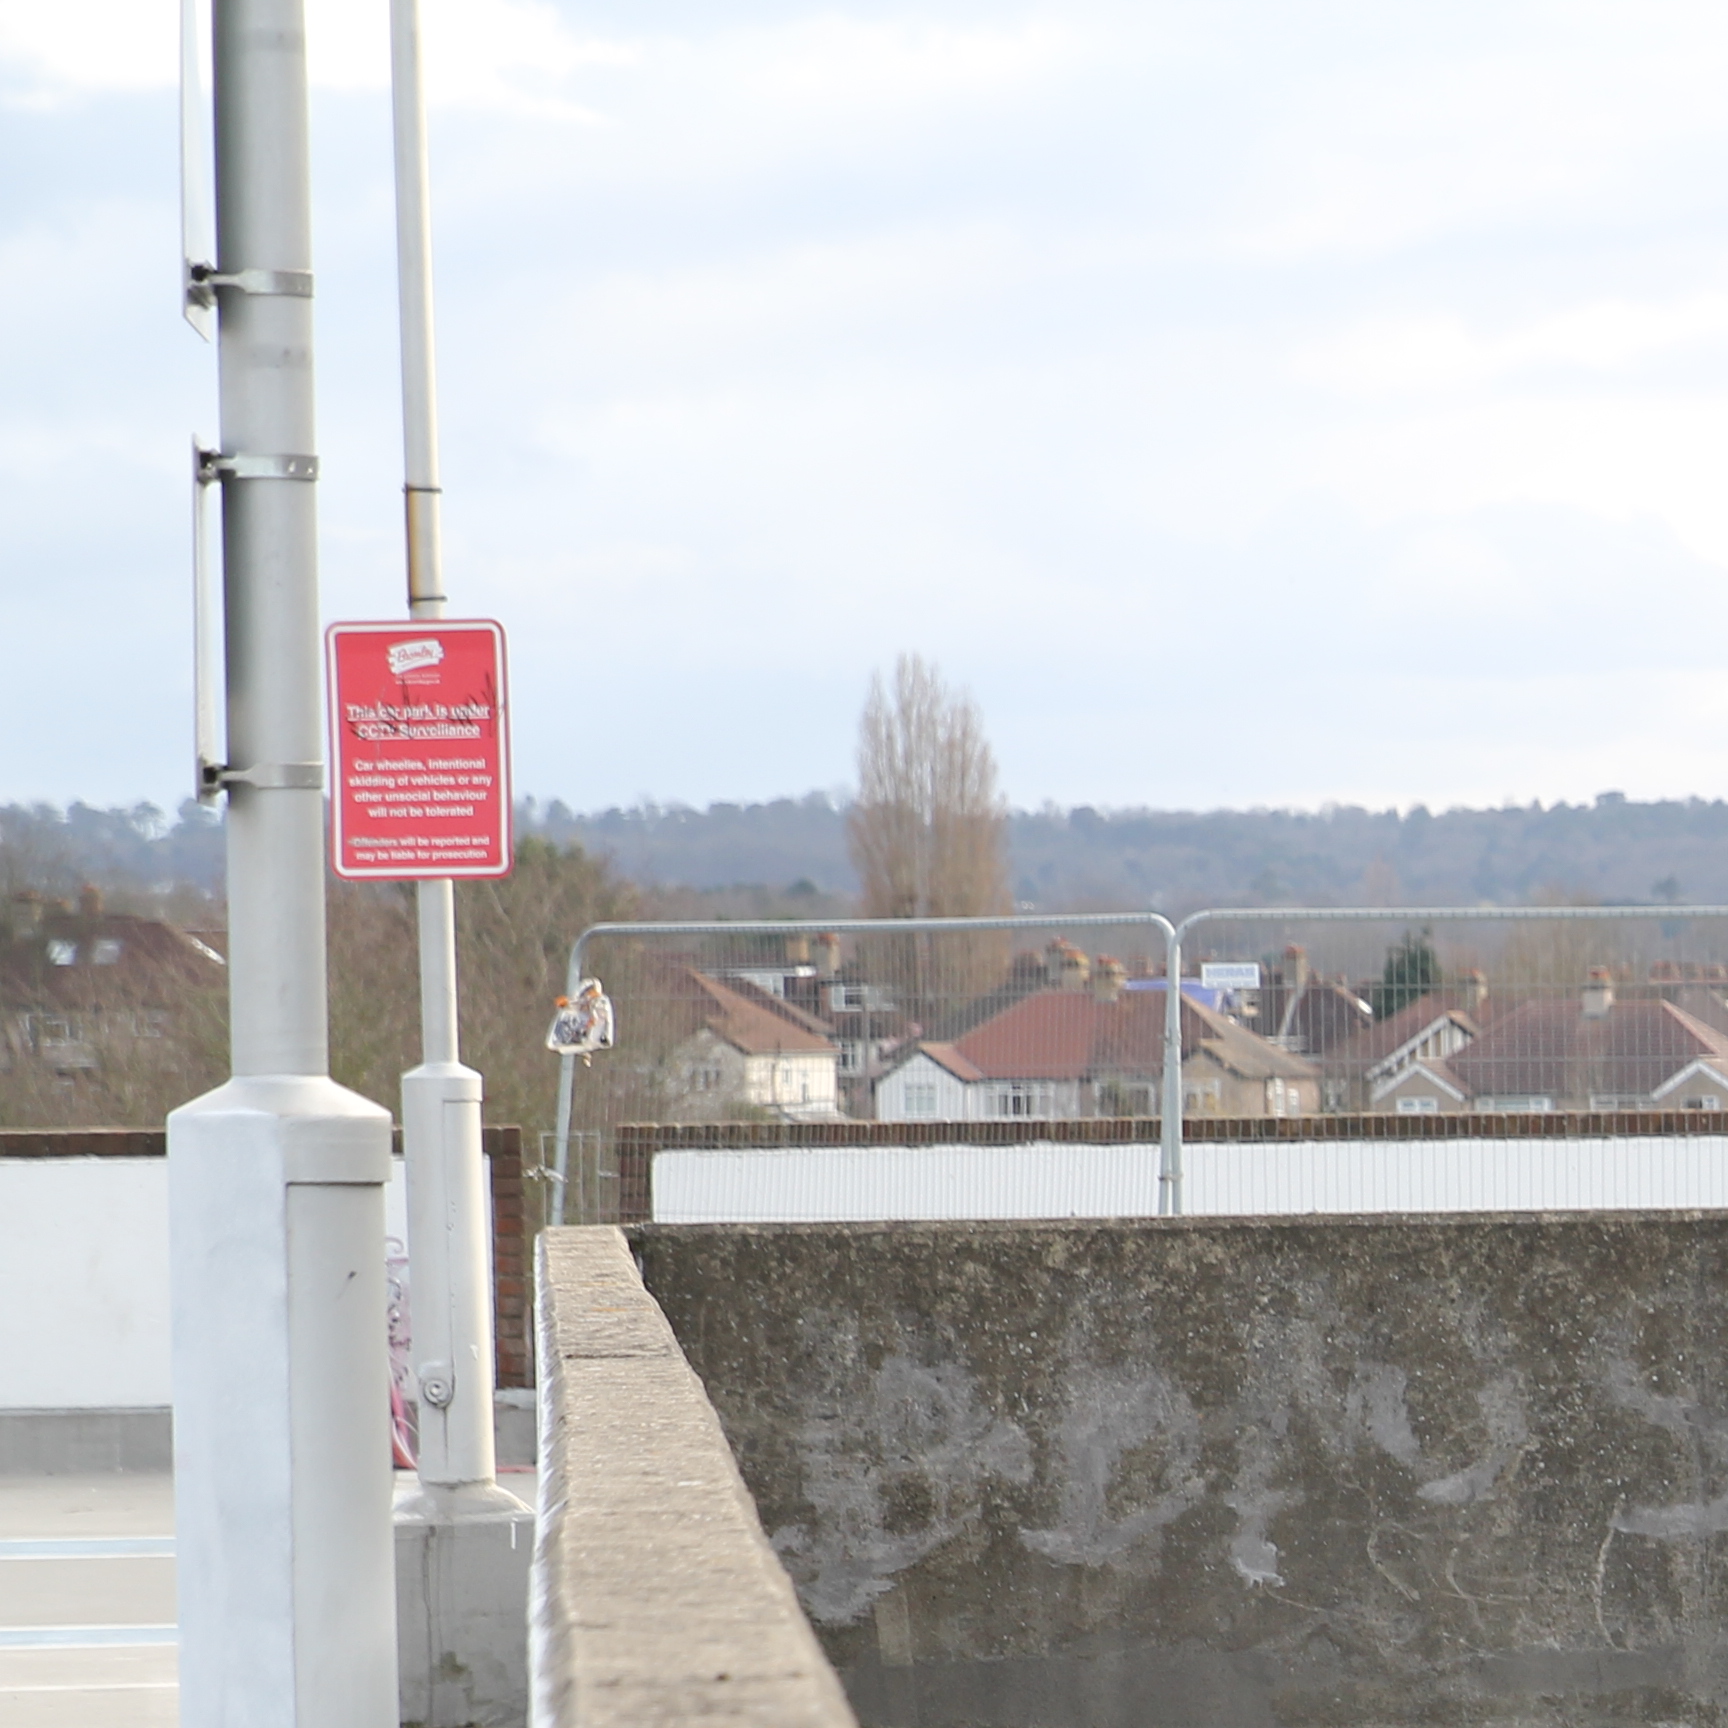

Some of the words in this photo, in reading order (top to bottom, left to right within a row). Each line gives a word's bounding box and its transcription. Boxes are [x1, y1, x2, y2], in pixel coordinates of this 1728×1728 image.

[347, 704, 376, 719] This
[403, 703, 432, 719] park
[436, 703, 448, 717] is
[452, 702, 490, 717] under
[399, 723, 481, 737] Surveillance
[354, 760, 374, 771] Car
[377, 759, 427, 772] wheelies,
[428, 758, 486, 770] intentional
[349, 776, 396, 789] skidding
[397, 776, 409, 786] of
[411, 775, 456, 786] vehicles
[458, 776, 470, 785] or
[472, 775, 492, 787] any
[354, 791, 382, 802] other
[385, 790, 431, 802] unsocial
[433, 790, 488, 801] behaviour
[368, 806, 387, 818] will
[390, 807, 407, 818] not
[410, 806, 424, 817] be
[425, 806, 474, 817] tolerated
[400, 836, 416, 846] will
[417, 836, 430, 847] be
[431, 835, 470, 848] reported
[472, 835, 490, 846] and
[356, 851, 375, 862] may
[377, 850, 389, 860] be
[391, 849, 415, 860] liable
[417, 849, 430, 860] for
[432, 849, 488, 861] prosecution
